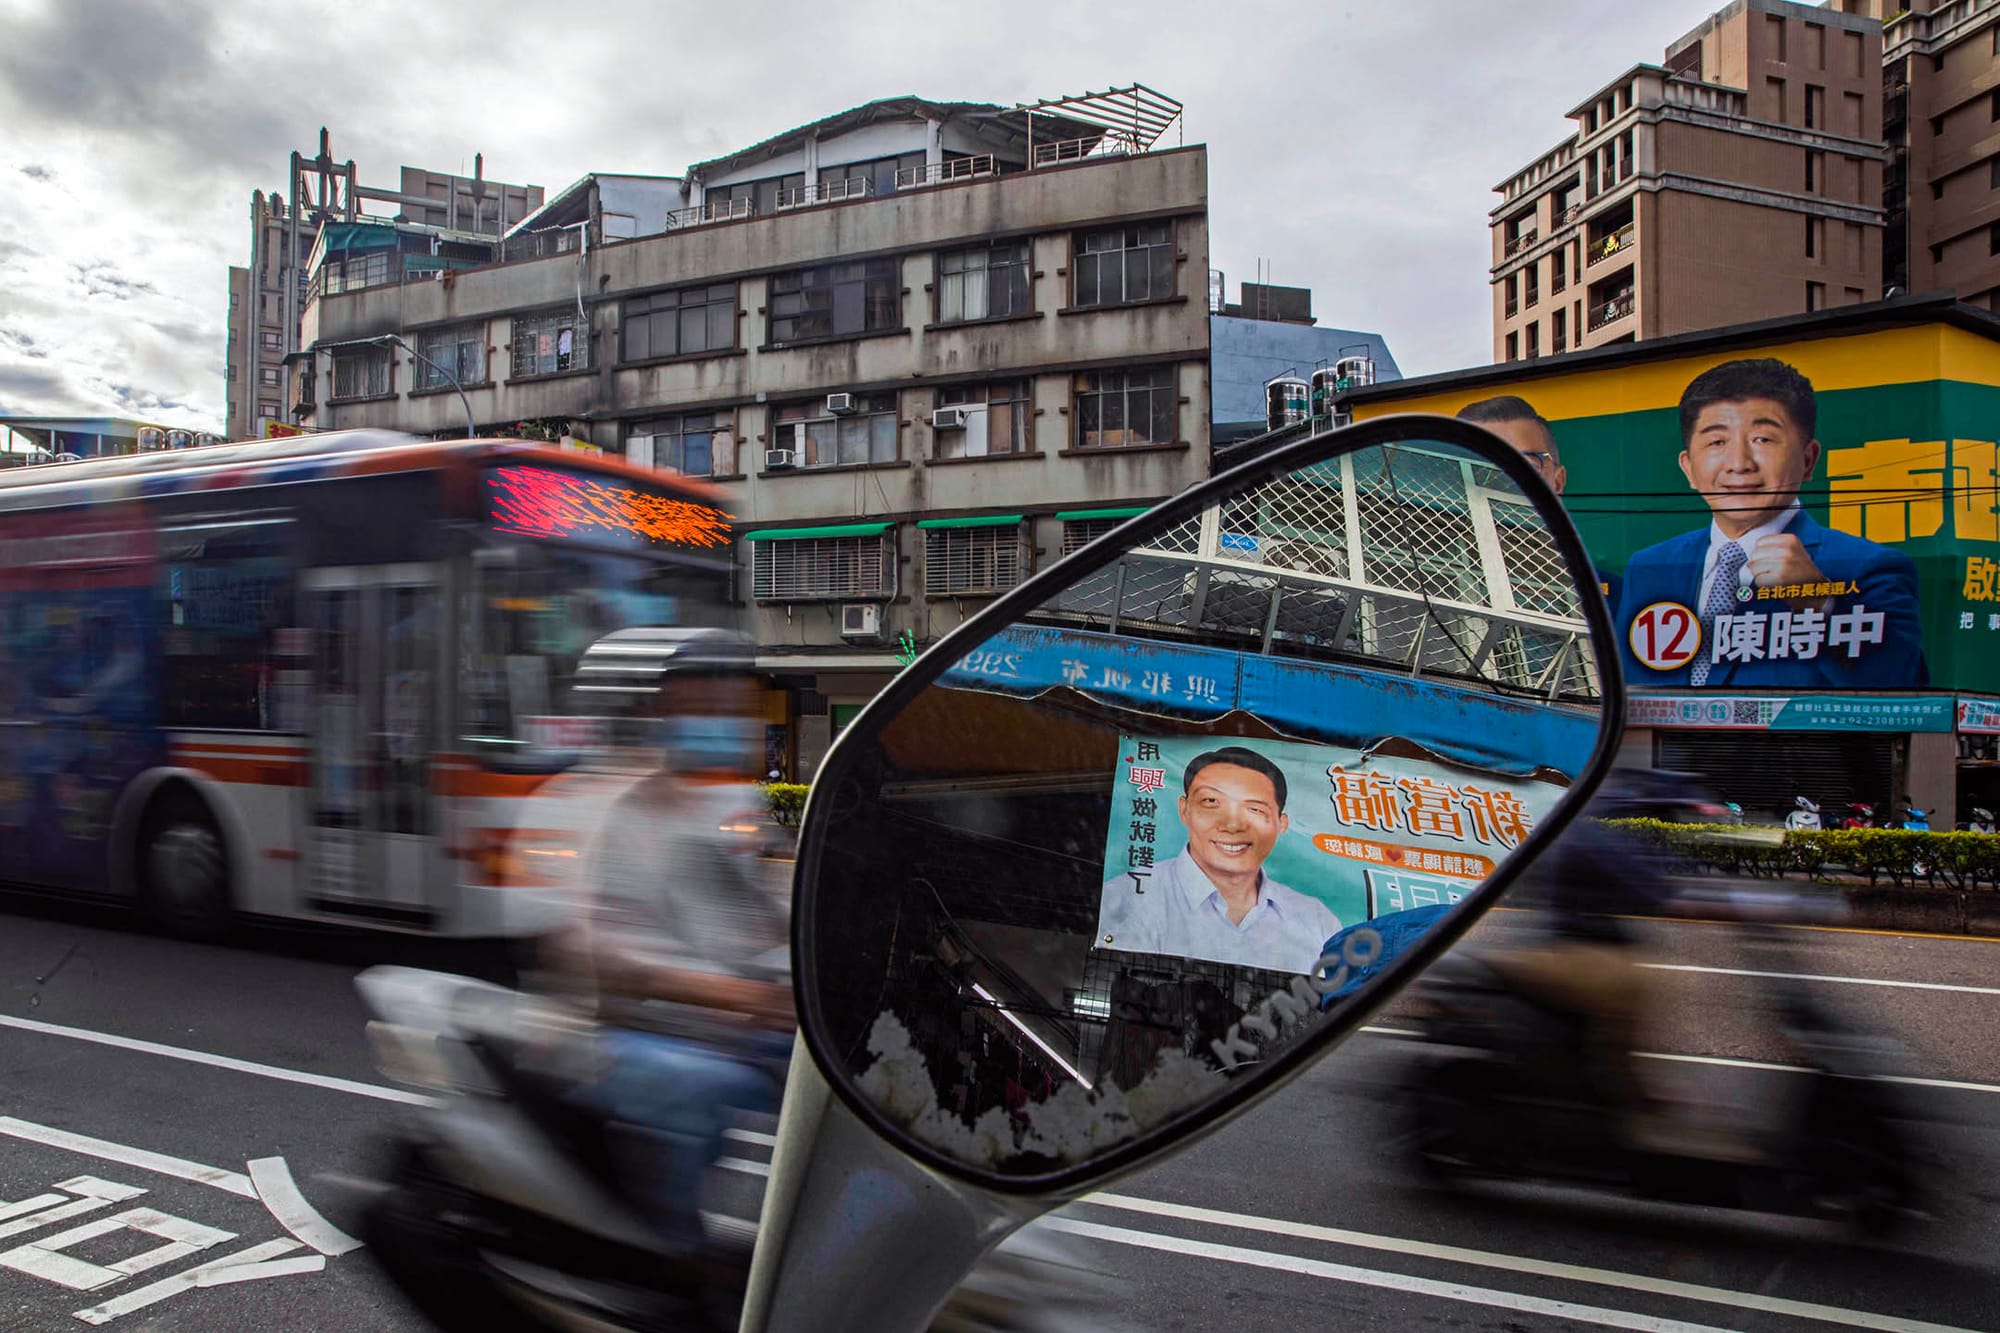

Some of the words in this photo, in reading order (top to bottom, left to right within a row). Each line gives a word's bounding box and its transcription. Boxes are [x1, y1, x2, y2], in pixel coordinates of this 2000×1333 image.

[1756, 580, 1861, 600] 台北市長候選人
[1963, 556, 2000, 601] 啟
[1638, 607, 1691, 662] 12
[1711, 604, 1886, 664] 陳時中
[1210, 927, 1383, 1071] KYMCO
